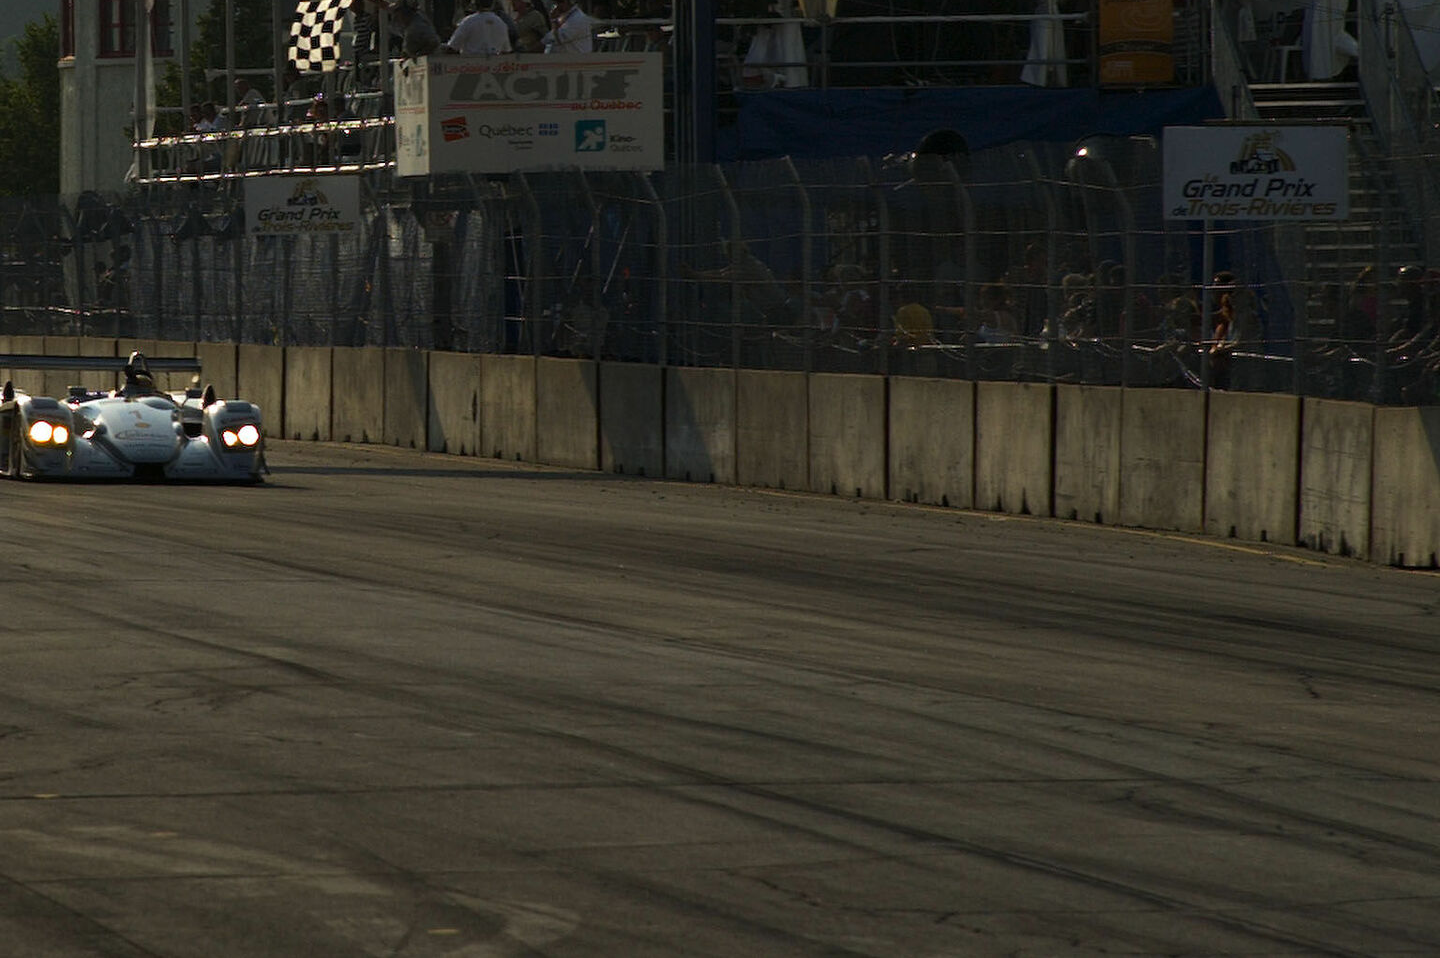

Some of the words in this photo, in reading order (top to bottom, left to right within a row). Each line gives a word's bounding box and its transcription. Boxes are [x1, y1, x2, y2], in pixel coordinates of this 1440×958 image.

[479, 124, 533, 138] Québec
[1183, 179, 1258, 198] Grand
[1265, 178, 1317, 197] Prix
[258, 208, 305, 221] Grand
[309, 207, 340, 220] Prix
